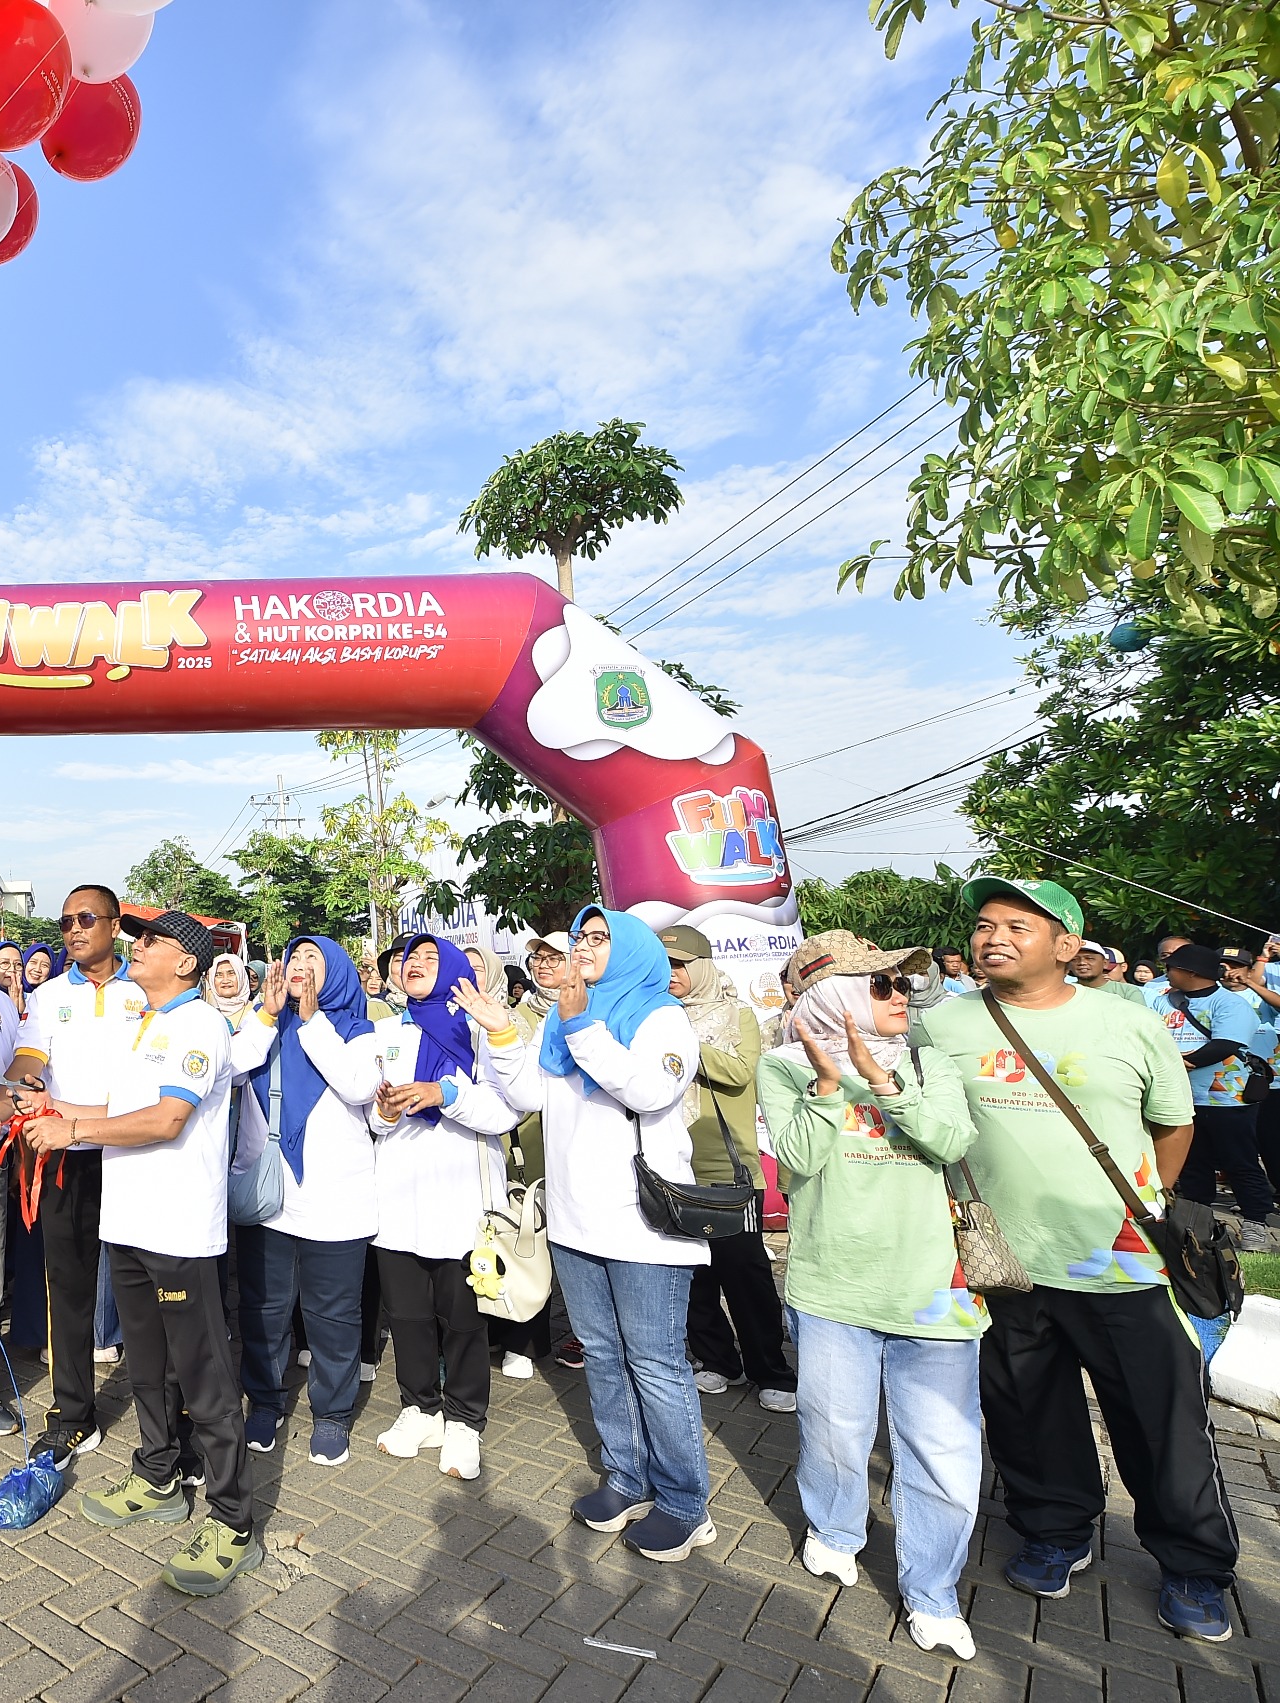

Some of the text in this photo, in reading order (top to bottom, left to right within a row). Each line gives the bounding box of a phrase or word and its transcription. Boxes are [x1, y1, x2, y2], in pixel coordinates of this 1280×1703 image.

[233, 590, 446, 622] HAKORDIA
[234, 622, 448, 643] & HUT KORPRI KE-54
[177, 656, 213, 671] 2025
[339, 645, 383, 665] BASMI
[678, 789, 771, 835] FUN
[673, 821, 784, 869] WALK
[979, 1096, 1034, 1107] KABUPATEN
[844, 1152, 894, 1161] KABUPATEN
[164, 1290, 187, 1302] SAMBA
